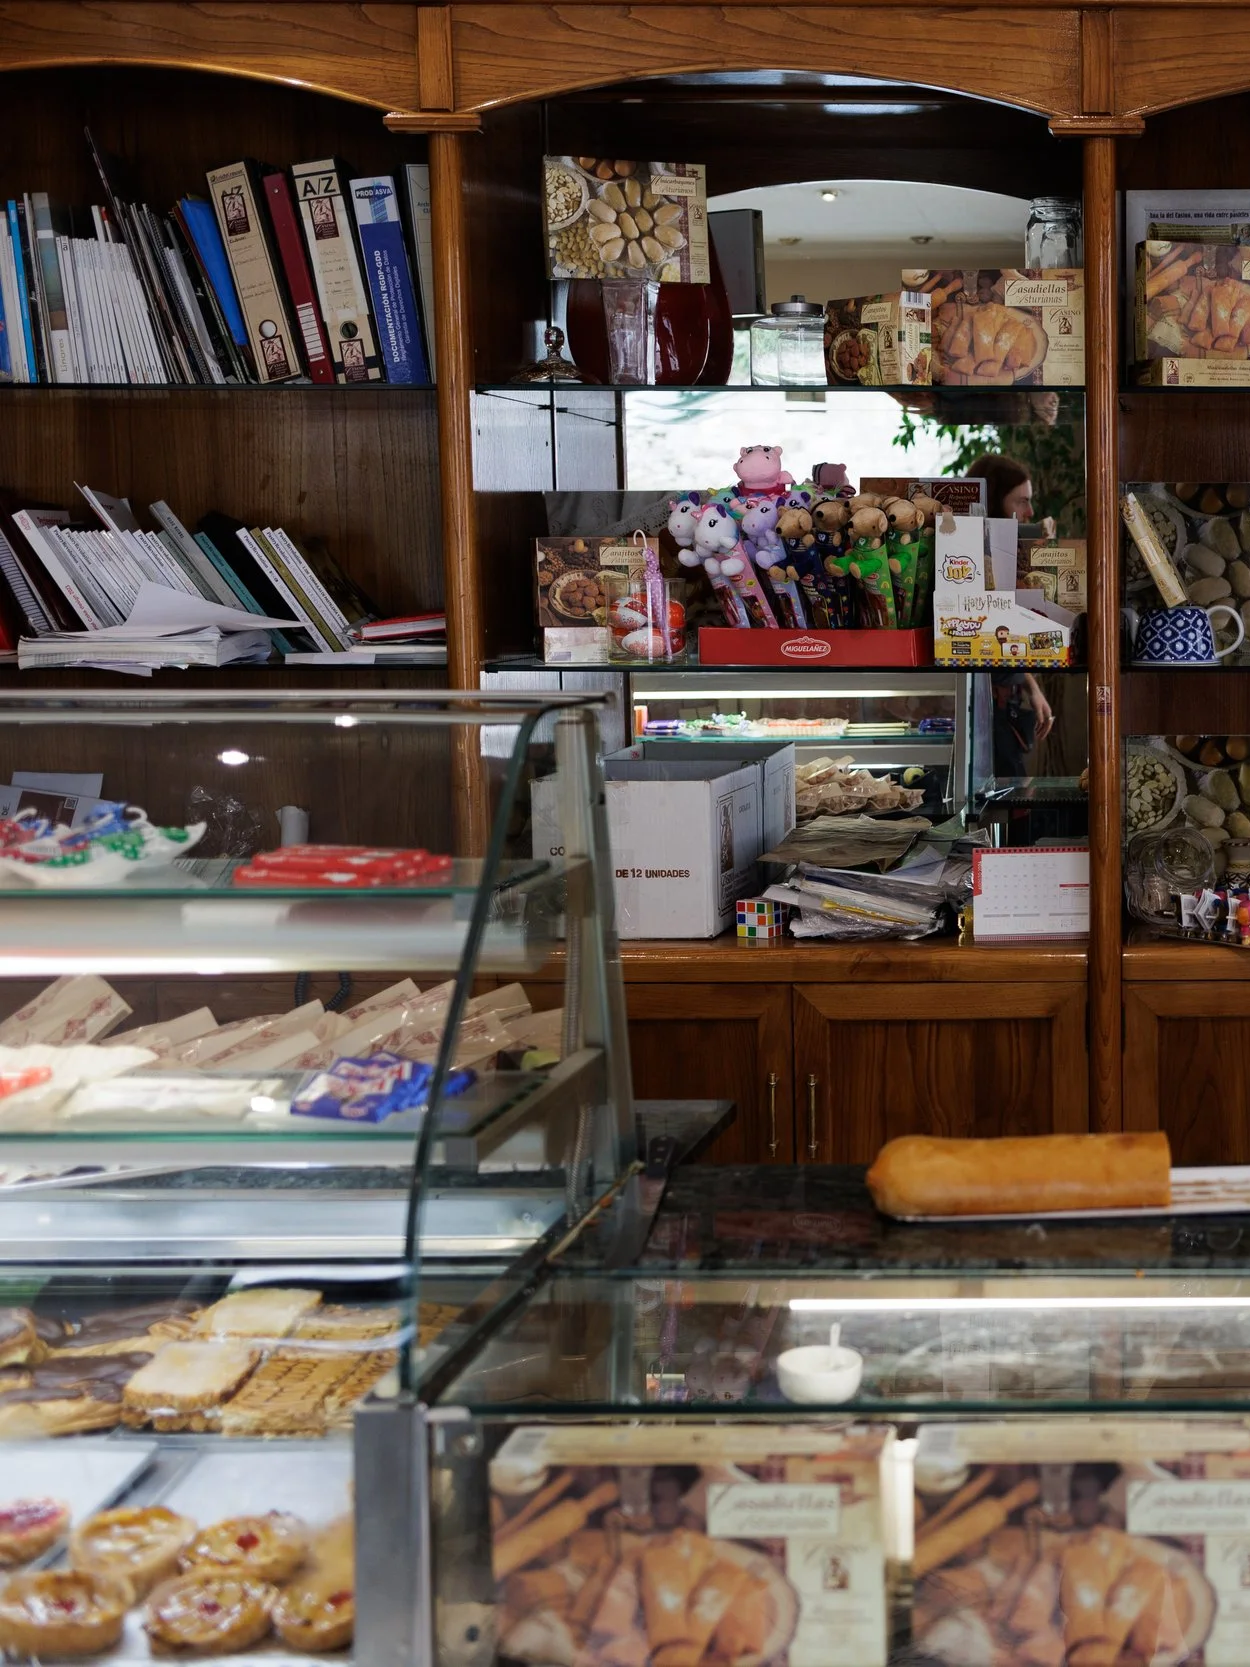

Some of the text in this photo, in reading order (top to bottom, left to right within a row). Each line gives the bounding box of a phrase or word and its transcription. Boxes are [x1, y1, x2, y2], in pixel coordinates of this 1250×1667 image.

[303, 176, 336, 197] A/Z
[1006, 278, 1066, 296] Casadiellas
[1012, 294, 1063, 304] Asturianas
[1049, 309, 1081, 323] CASINO
[58, 338, 68, 373] Linares
[933, 482, 978, 500] CASINO
[601, 546, 638, 558] Carajitos
[1031, 546, 1068, 559] Carajitos
[964, 595, 987, 611] Harry
[987, 595, 1012, 613] Potter
[784, 644, 827, 652] MIGUELAÑEZ
[616, 868, 690, 878] DE 12 UNIDADES
